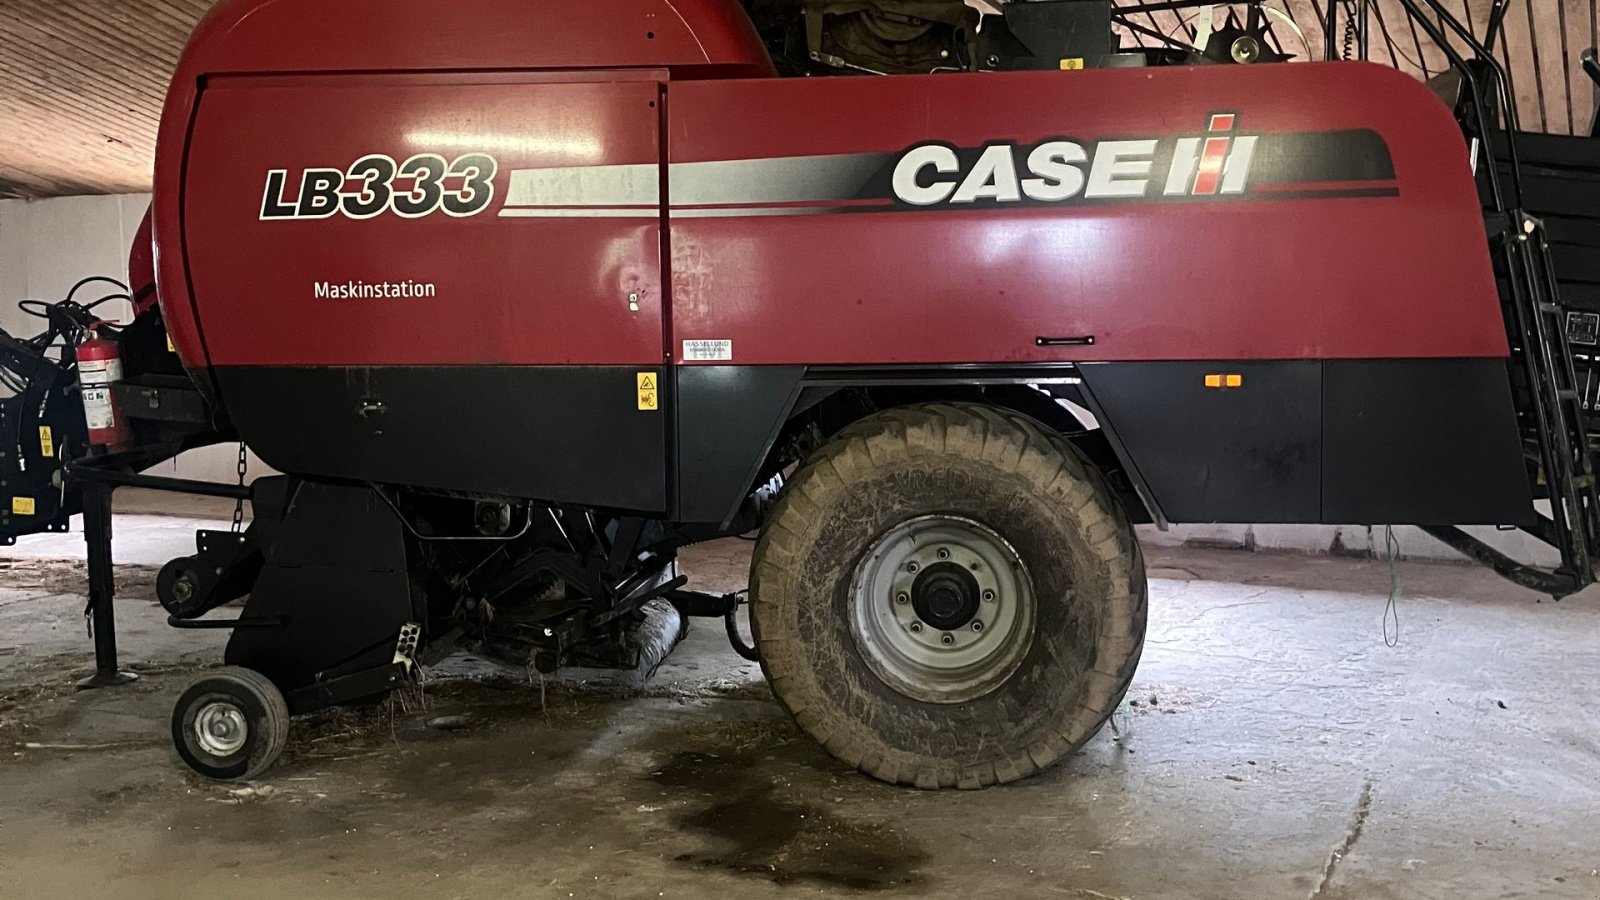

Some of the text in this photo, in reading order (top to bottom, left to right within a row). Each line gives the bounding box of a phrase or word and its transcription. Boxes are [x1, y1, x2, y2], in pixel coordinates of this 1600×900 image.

[259, 152, 498, 220] LB333
[892, 139, 1158, 205] CASE
[314, 280, 435, 298] Maskinstation
